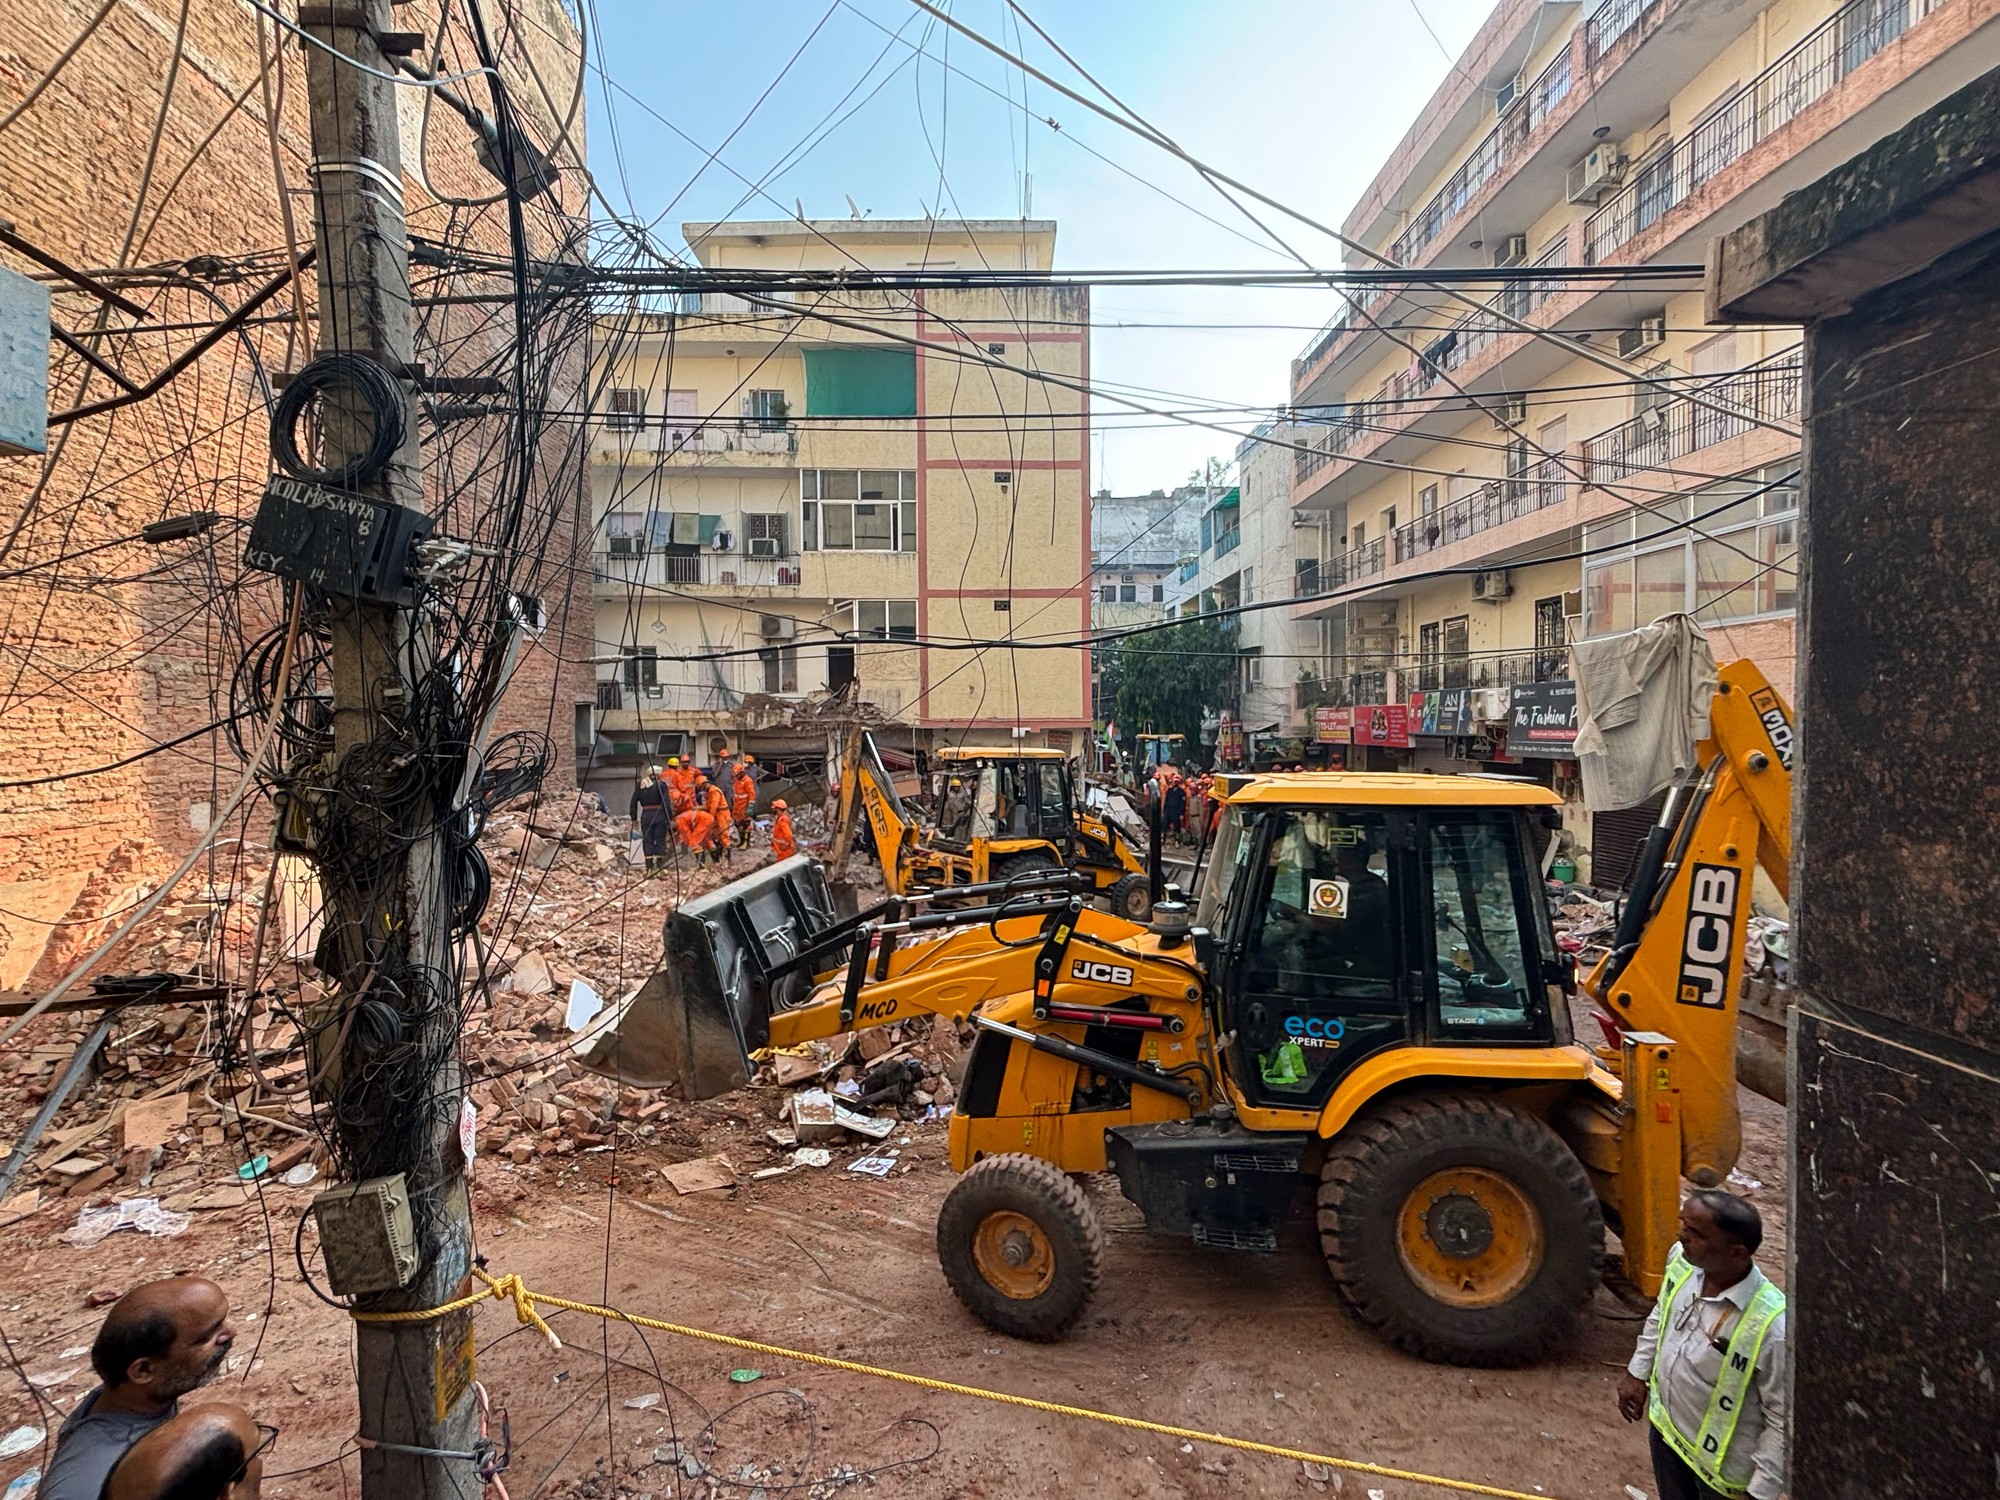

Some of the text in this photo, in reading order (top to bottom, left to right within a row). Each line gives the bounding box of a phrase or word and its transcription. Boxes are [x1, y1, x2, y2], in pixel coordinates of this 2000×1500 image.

[245, 547, 284, 571] KEY
[309, 567, 327, 584] 14
[1515, 706, 1528, 727] The
[1531, 705, 1566, 727] Fashion
[1763, 709, 1793, 762] 3DX
[1090, 827, 1106, 838] JCB
[1684, 867, 1736, 1005] JCB
[1073, 961, 1133, 985] JCB
[859, 998, 898, 1020] MCD
[1284, 1015, 1345, 1040] eco
[1289, 1036, 1325, 1048] XPERT
